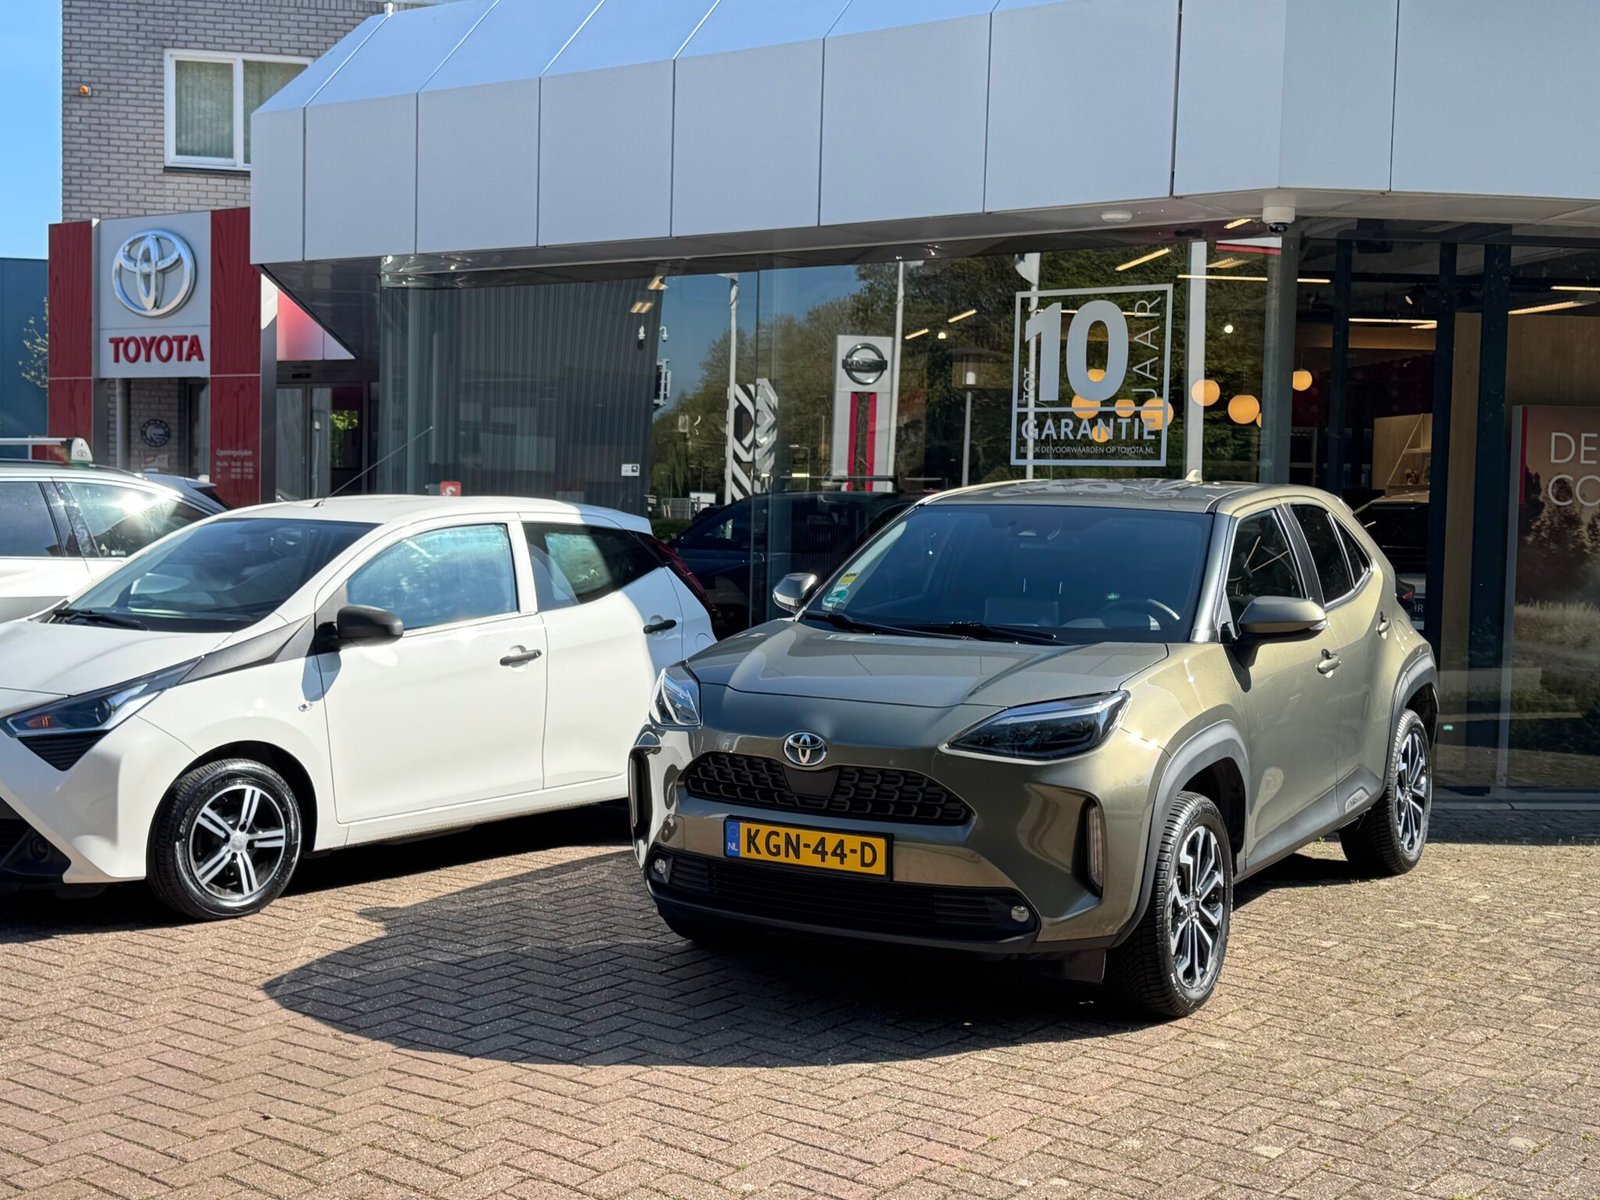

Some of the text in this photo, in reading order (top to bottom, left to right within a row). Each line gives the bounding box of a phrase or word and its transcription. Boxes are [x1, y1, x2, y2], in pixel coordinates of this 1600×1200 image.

[109, 335, 204, 363] TOYOTA
[1025, 300, 1129, 401] 10
[1131, 297, 1161, 399] JAAR
[1021, 417, 1156, 440] GARANTIE
[1052, 446, 1104, 454] VOORWAARDEN
[1105, 446, 1116, 454] OP
[1117, 446, 1154, 454] TOYOTA.NL
[1550, 431, 1598, 464] DE
[728, 828, 877, 868] NL KGN-44-D
